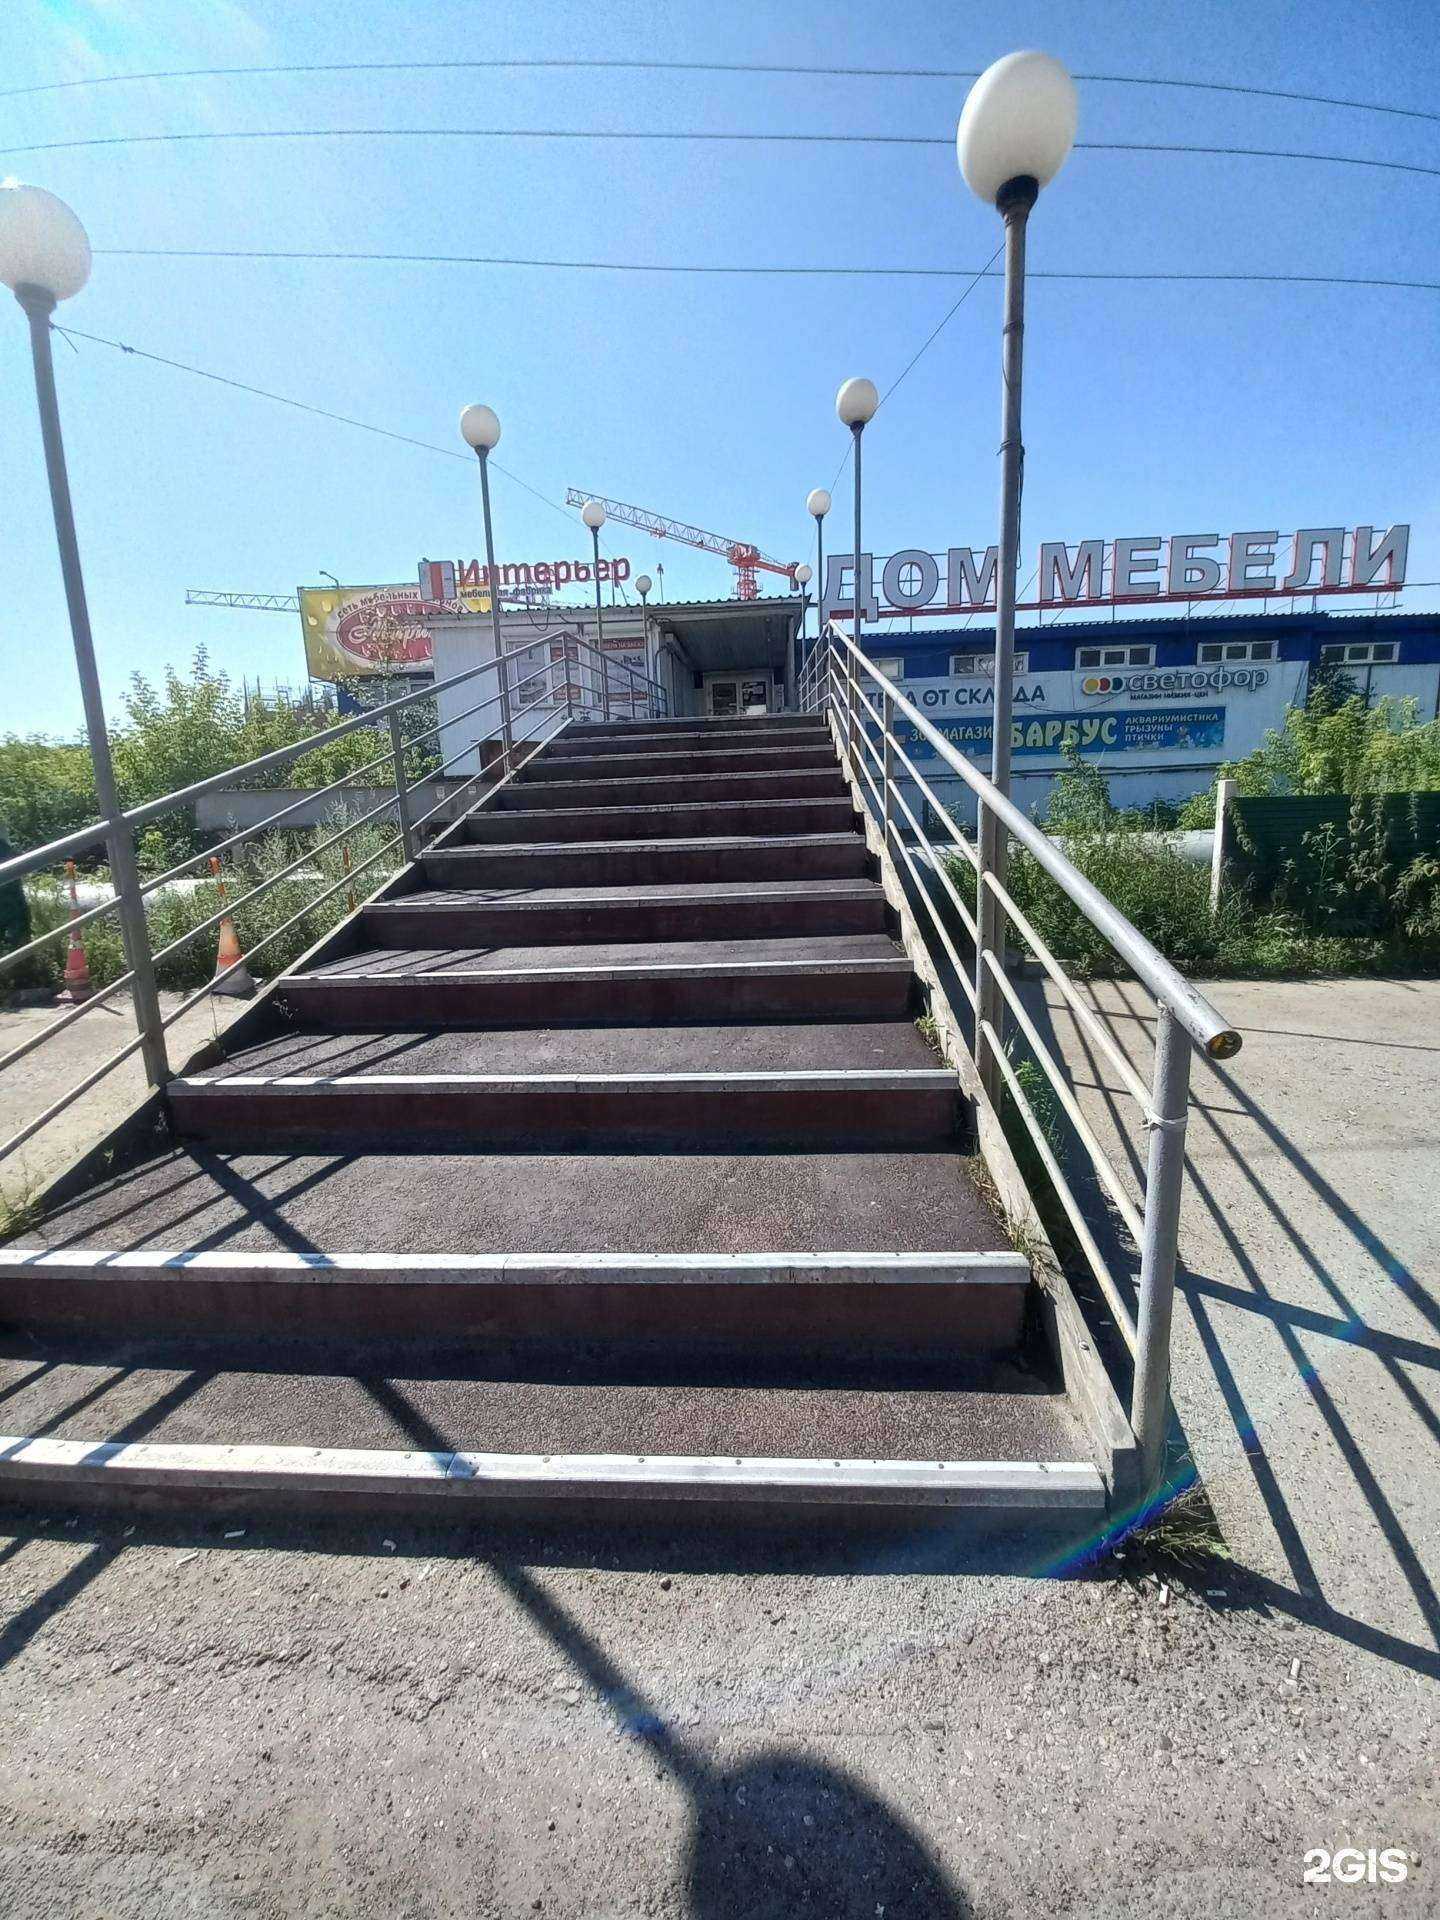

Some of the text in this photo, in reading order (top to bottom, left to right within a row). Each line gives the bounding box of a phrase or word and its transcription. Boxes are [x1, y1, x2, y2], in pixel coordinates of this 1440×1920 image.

[457, 557, 631, 590] Интерьер
[818, 524, 1410, 625] ДОМ МЕБЕЛИ
[1128, 665, 1269, 693] светофор
[922, 689, 950, 707] ОТ
[954, 685, 1046, 706] СКЛДА
[1125, 713, 1219, 725] АКВАРИУМИСТИКА
[1125, 723, 1173, 733] ГРЫЗУНЫ
[910, 716, 1118, 749] ЗОМАГАЗИ БАРБУС
[1124, 731, 1165, 742] ПТИЧКИ
